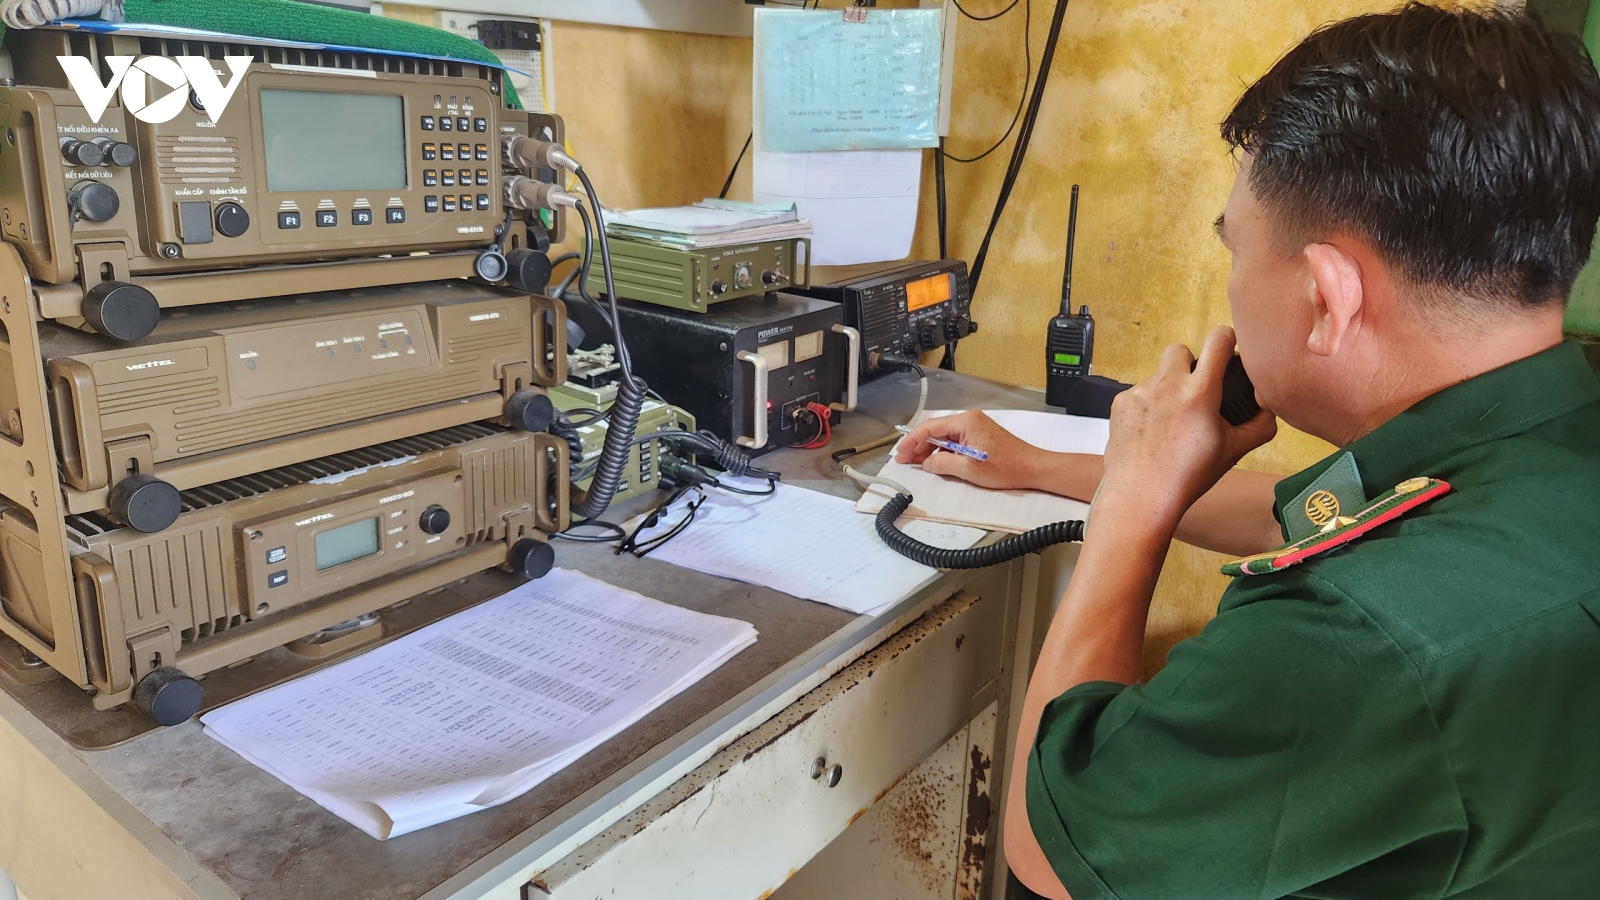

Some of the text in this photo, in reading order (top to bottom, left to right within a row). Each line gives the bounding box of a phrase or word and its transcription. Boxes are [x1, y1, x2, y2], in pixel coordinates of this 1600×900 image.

[77, 124, 90, 133] ĐIỀU
[66, 170, 77, 179] KẾT
[79, 170, 89, 178] NỐI
[100, 171, 113, 179] LIỆU
[175, 187, 204, 195] KHẨN CẤP
[324, 215, 334, 223] F2
[393, 212, 402, 220] F4
[286, 217, 296, 225] F1
[758, 327, 779, 339] POWER
